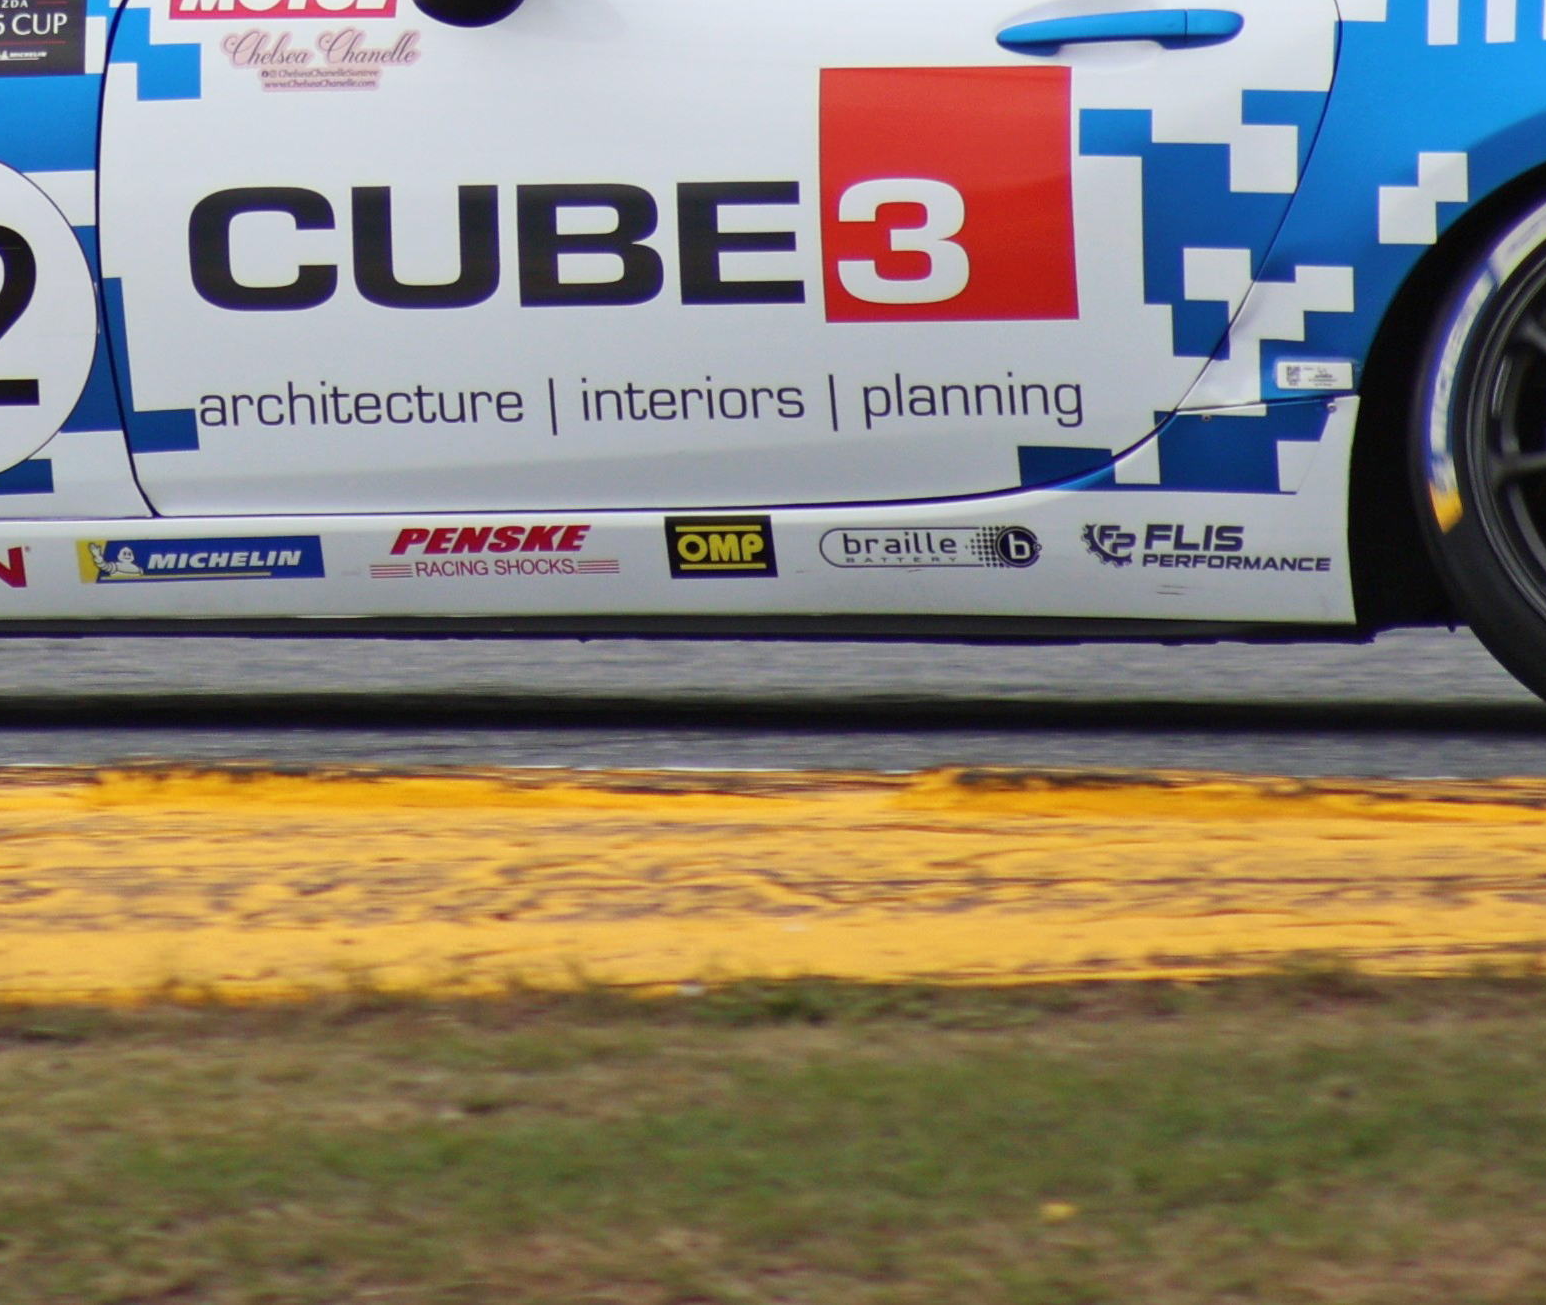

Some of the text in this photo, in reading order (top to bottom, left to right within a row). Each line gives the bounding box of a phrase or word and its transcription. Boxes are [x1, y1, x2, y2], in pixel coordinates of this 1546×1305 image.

[11, 13, 68, 36] CUP
[224, 28, 420, 65] Chelsea Chanelle
[198, 381, 524, 426] architecture
[581, 375, 805, 423] interiors
[862, 369, 1085, 428] planning
[390, 525, 591, 555] PENSKE
[678, 533, 764, 563] OMP
[843, 532, 957, 555] braille
[1144, 524, 1244, 552] FLIS
[147, 550, 301, 571] MICHELIN
[415, 558, 575, 578] RACING SHOCKS
[1142, 554, 1331, 572] PERFORMANCE
